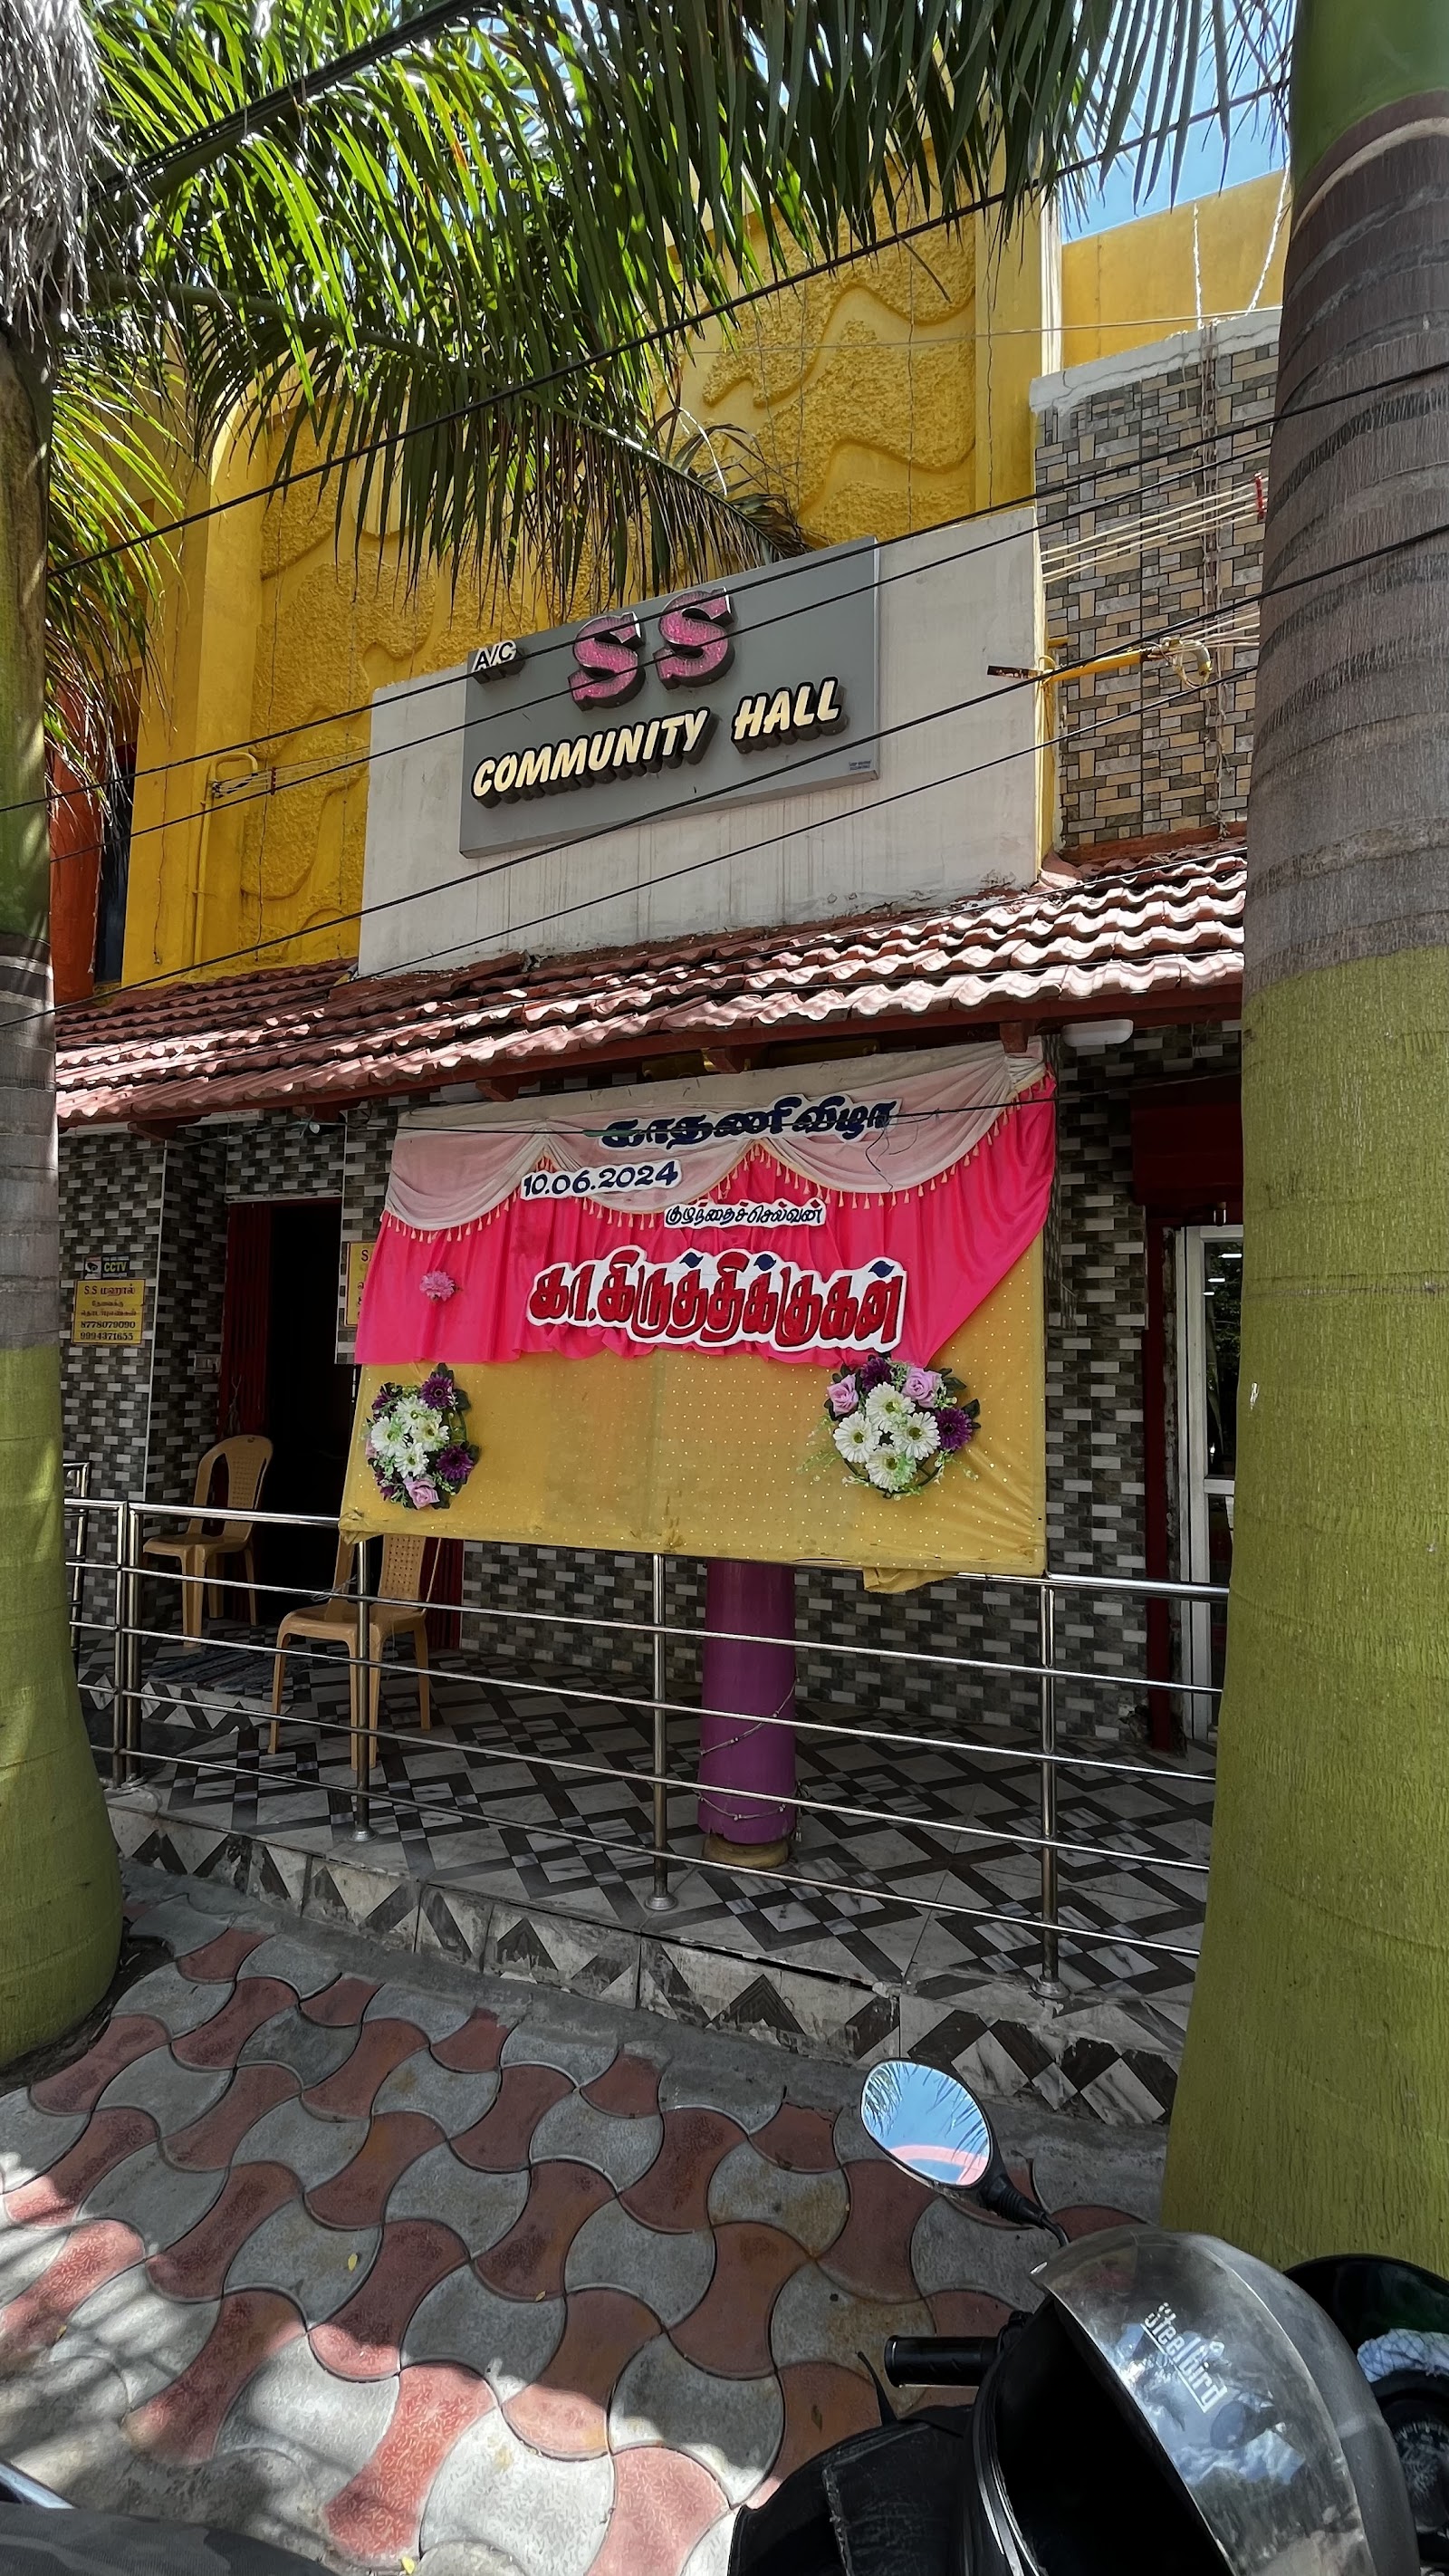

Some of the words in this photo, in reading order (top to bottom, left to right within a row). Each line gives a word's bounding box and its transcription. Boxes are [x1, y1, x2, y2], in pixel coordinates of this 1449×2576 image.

[471, 639, 518, 675] A/C
[471, 706, 713, 801] COMMUNITY
[731, 676, 843, 746] HALL
[523, 1160, 678, 1196] 10.06.2024
[103, 1262, 128, 1273] CCTV
